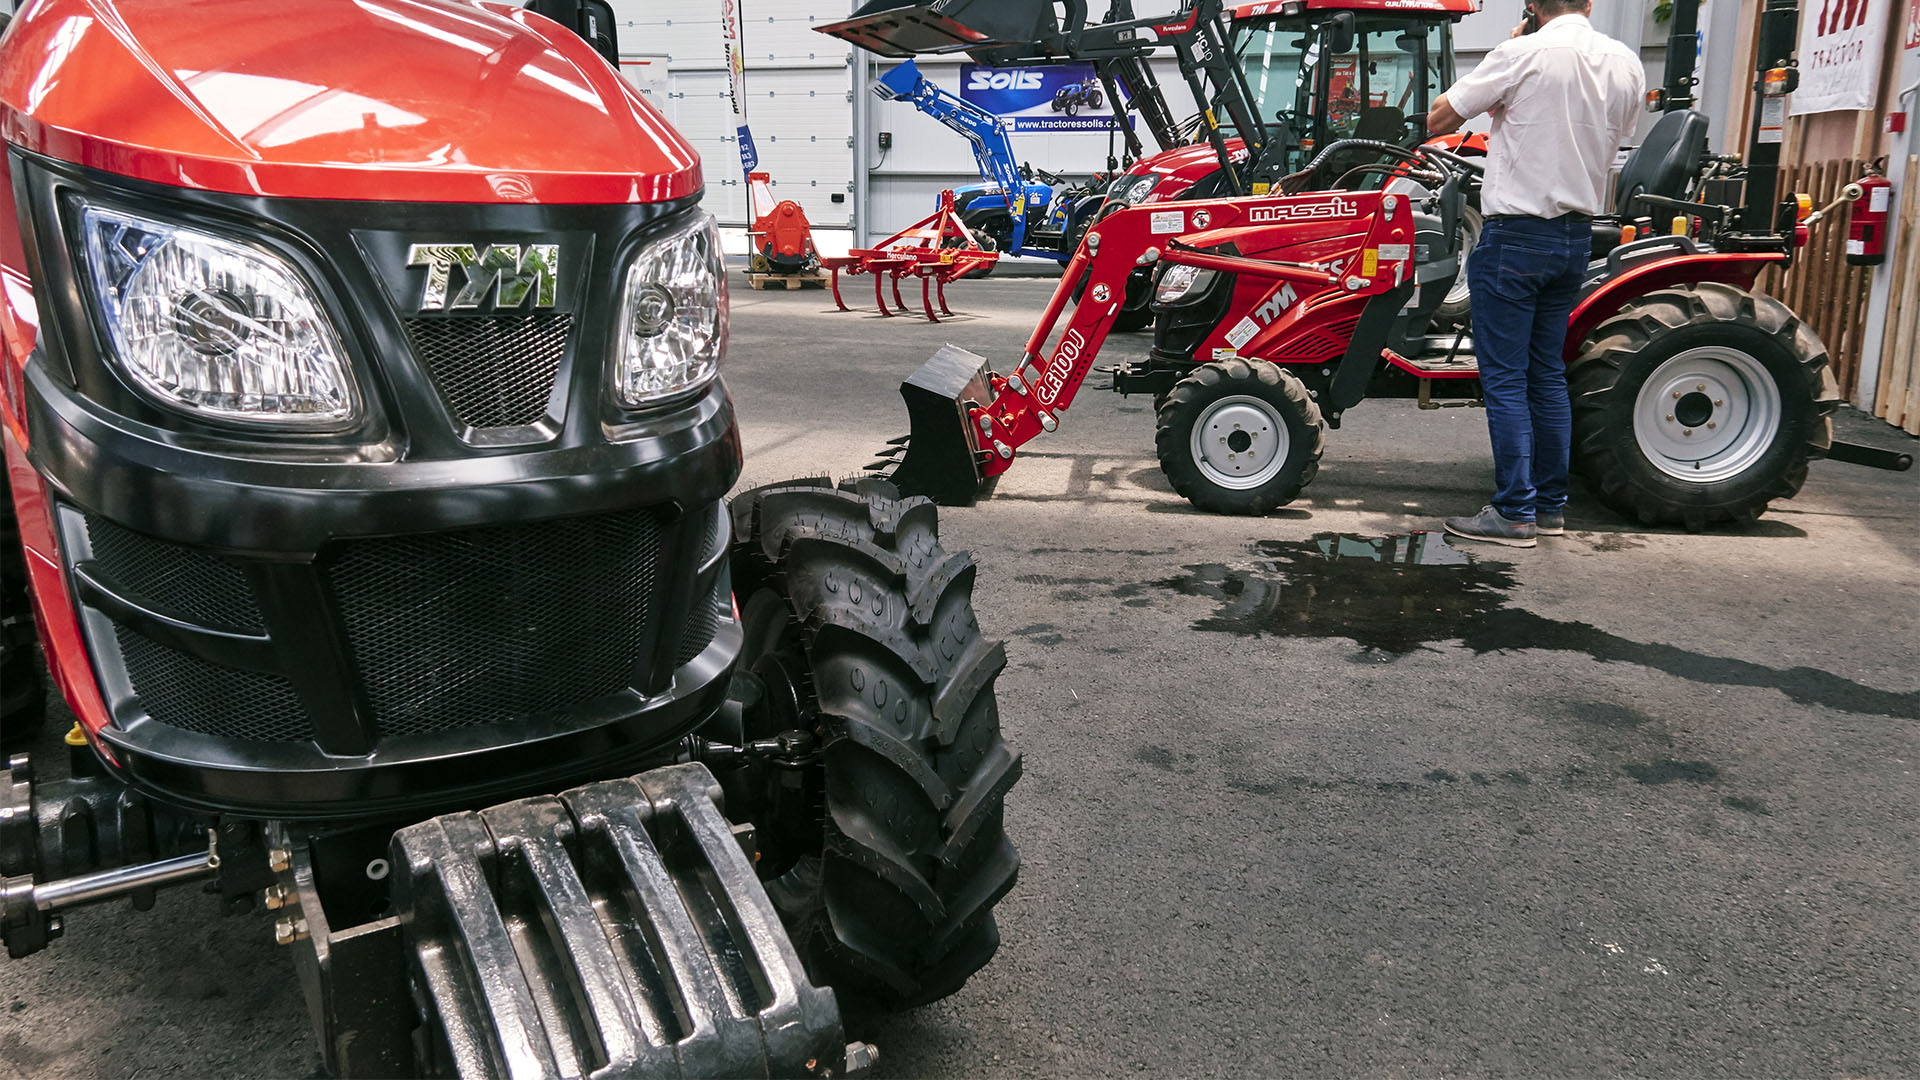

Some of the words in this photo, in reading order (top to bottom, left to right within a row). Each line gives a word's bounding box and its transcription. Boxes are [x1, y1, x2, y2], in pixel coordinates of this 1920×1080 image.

[1811, 39, 1863, 70] TRACTOR
[967, 71, 1044, 91] SOLIS
[959, 115, 978, 127] 3200
[406, 243, 559, 311] TYM
[1254, 282, 1298, 325] TYM
